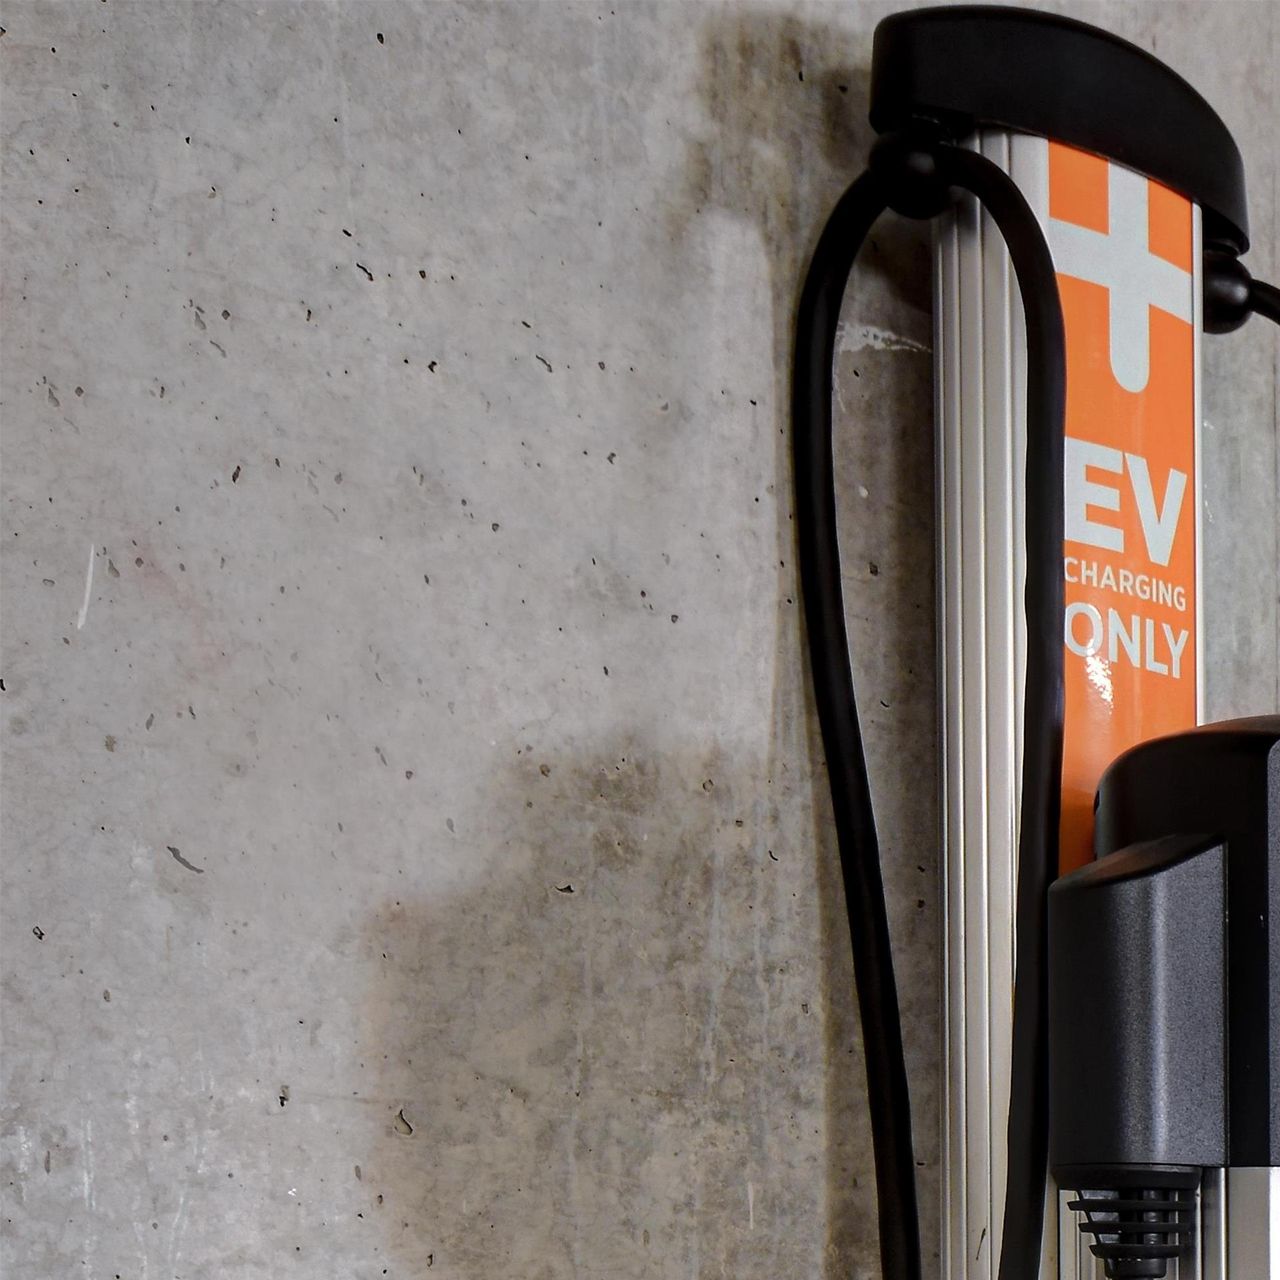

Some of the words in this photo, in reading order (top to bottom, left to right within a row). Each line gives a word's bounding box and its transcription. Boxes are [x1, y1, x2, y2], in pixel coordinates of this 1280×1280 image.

[1064, 436, 1188, 567] EV
[1064, 557, 1187, 612] CHARGING
[1064, 602, 1190, 680] ONLY
